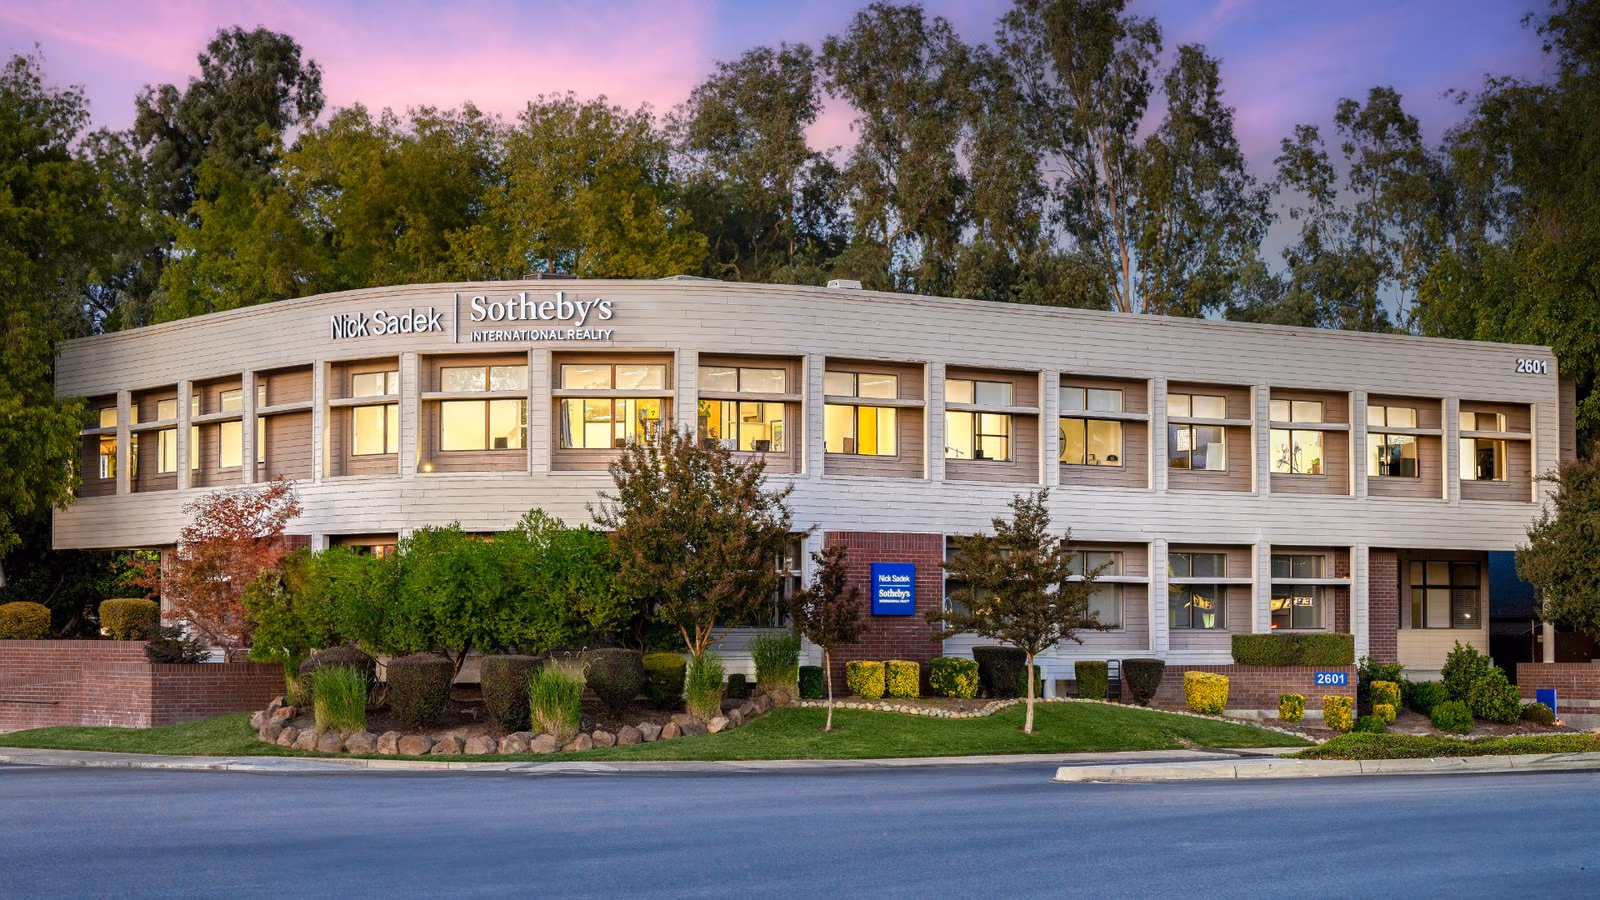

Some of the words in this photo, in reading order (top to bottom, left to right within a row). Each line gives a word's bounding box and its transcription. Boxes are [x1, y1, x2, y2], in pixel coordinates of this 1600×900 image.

[470, 291, 613, 327] Sotheby's
[331, 312, 369, 339] Nick
[373, 307, 443, 336] Sadek
[470, 329, 565, 342] INTERNATIONAL
[567, 329, 613, 341] REALTY
[1517, 358, 1547, 374] 2601
[878, 574, 892, 582] Nick
[1317, 673, 1345, 684] 2601
